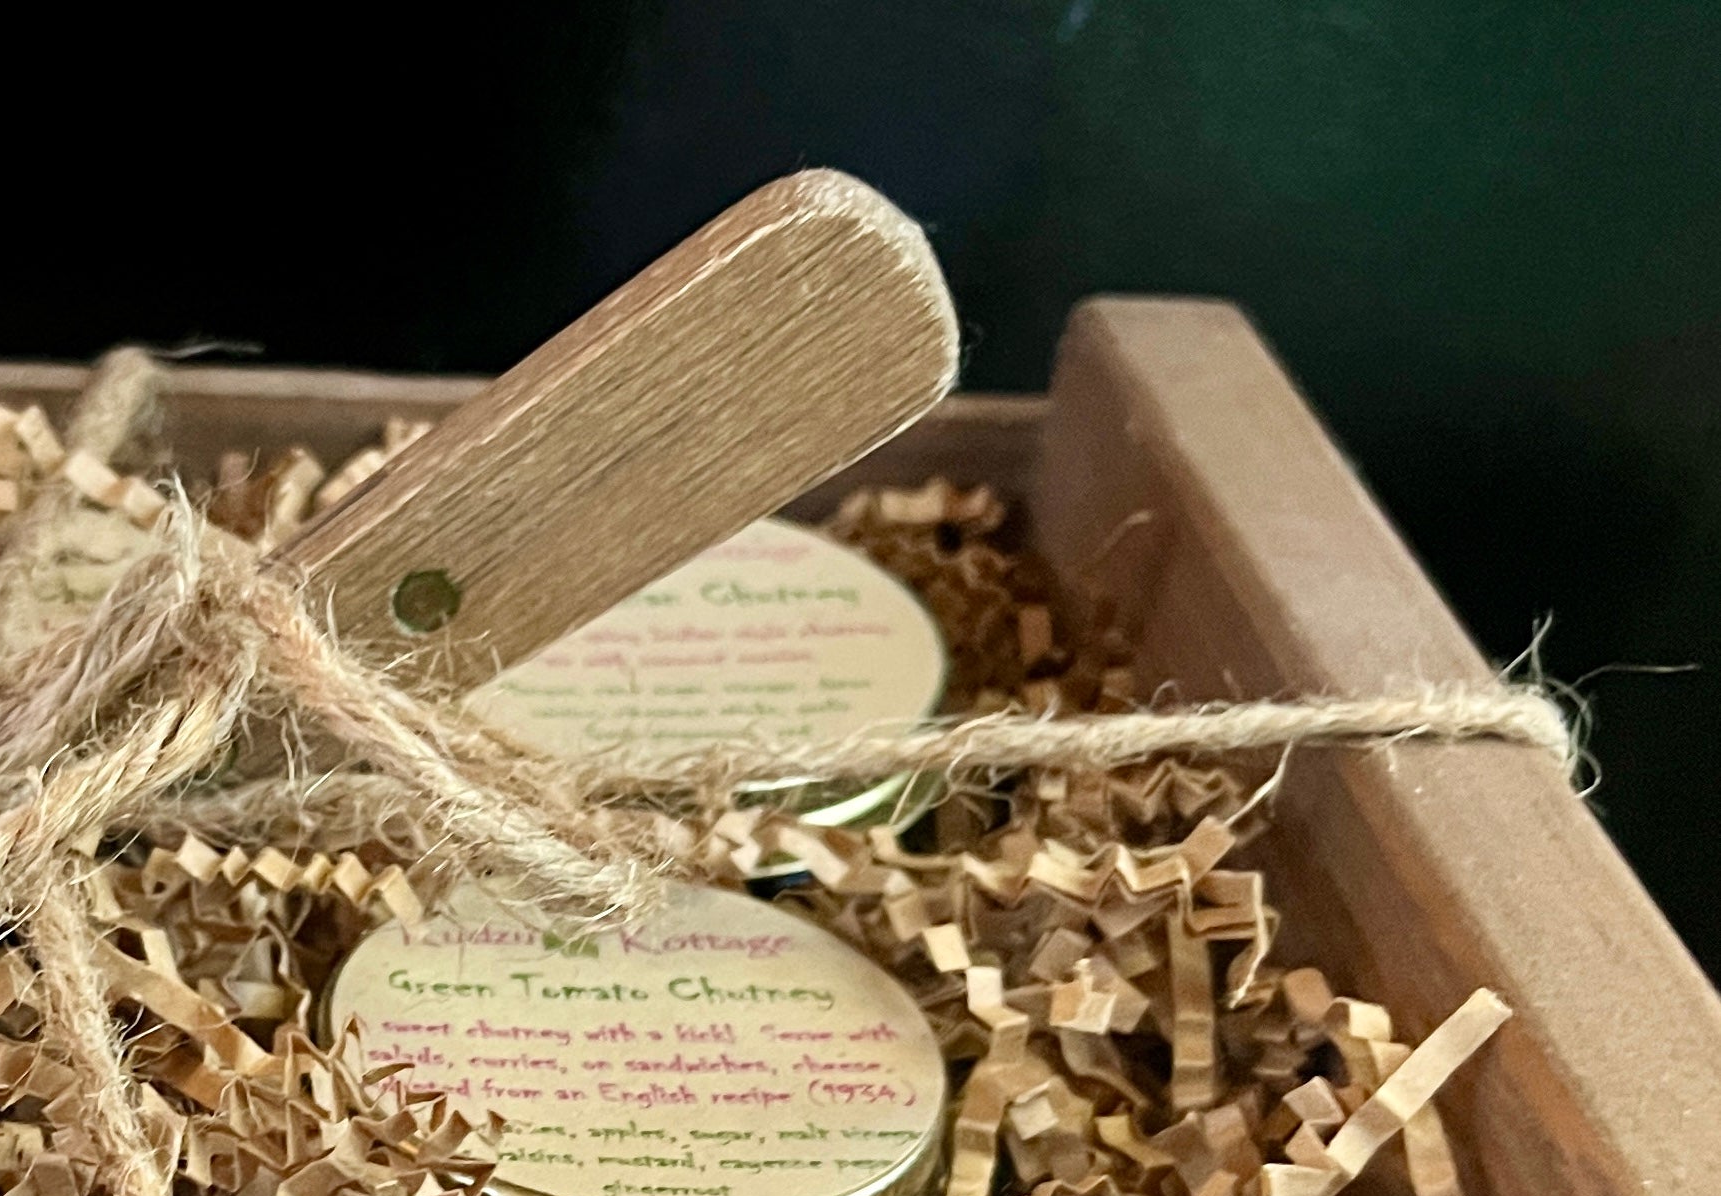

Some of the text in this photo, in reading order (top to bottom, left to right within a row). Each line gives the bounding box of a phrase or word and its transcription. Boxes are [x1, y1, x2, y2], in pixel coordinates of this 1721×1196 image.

[387, 968, 836, 1011] Green Tomato Chutney
[465, 1018, 572, 1047] chutney
[584, 1021, 638, 1044] with
[847, 1022, 899, 1043] with
[623, 1052, 779, 1077] sandwiches,
[481, 1077, 544, 1100] from
[597, 1080, 698, 1109] English
[711, 1086, 793, 1110] recipe
